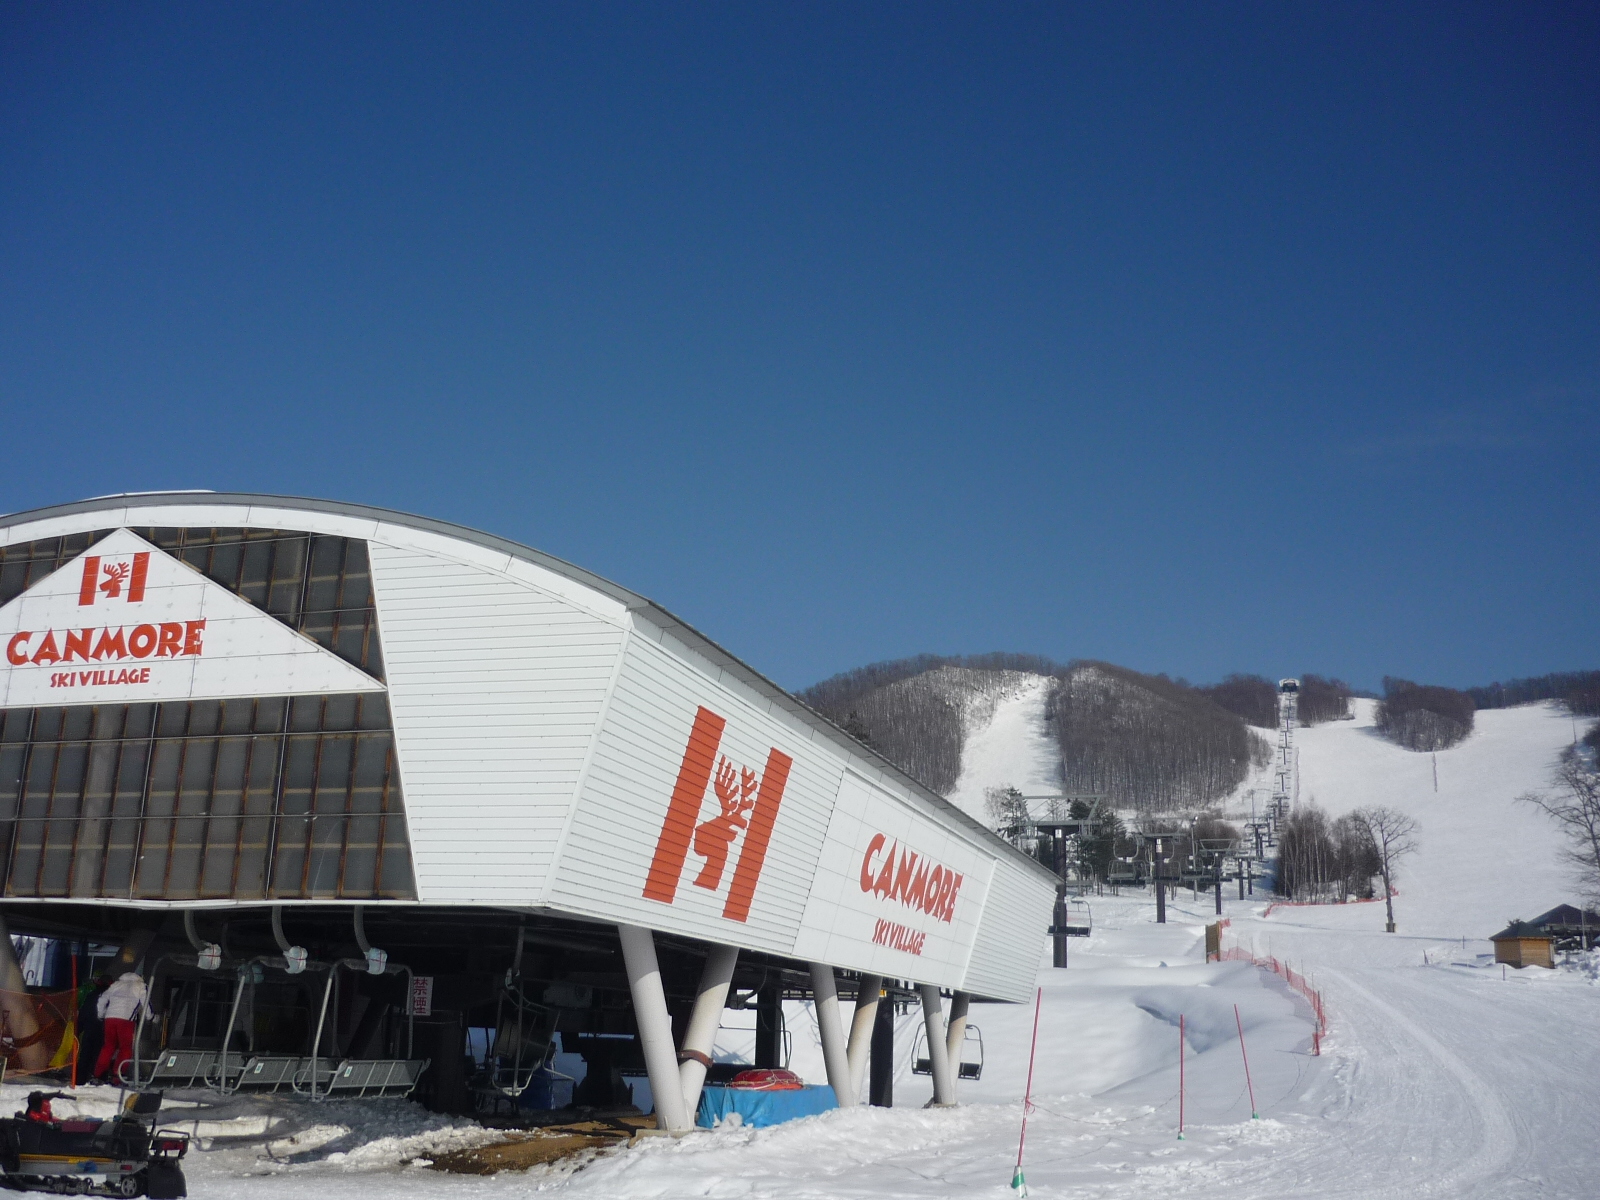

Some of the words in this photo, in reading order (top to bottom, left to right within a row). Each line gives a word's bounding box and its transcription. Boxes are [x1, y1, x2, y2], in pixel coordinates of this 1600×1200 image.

[6, 618, 207, 666] CANMORE
[50, 672, 77, 688] SKI
[79, 667, 151, 687] VILLAGE
[860, 832, 964, 925] CANMORE
[872, 917, 891, 946] SKI
[889, 922, 926, 956] VILLAGE
[412, 977, 428, 1014] 禁煙
